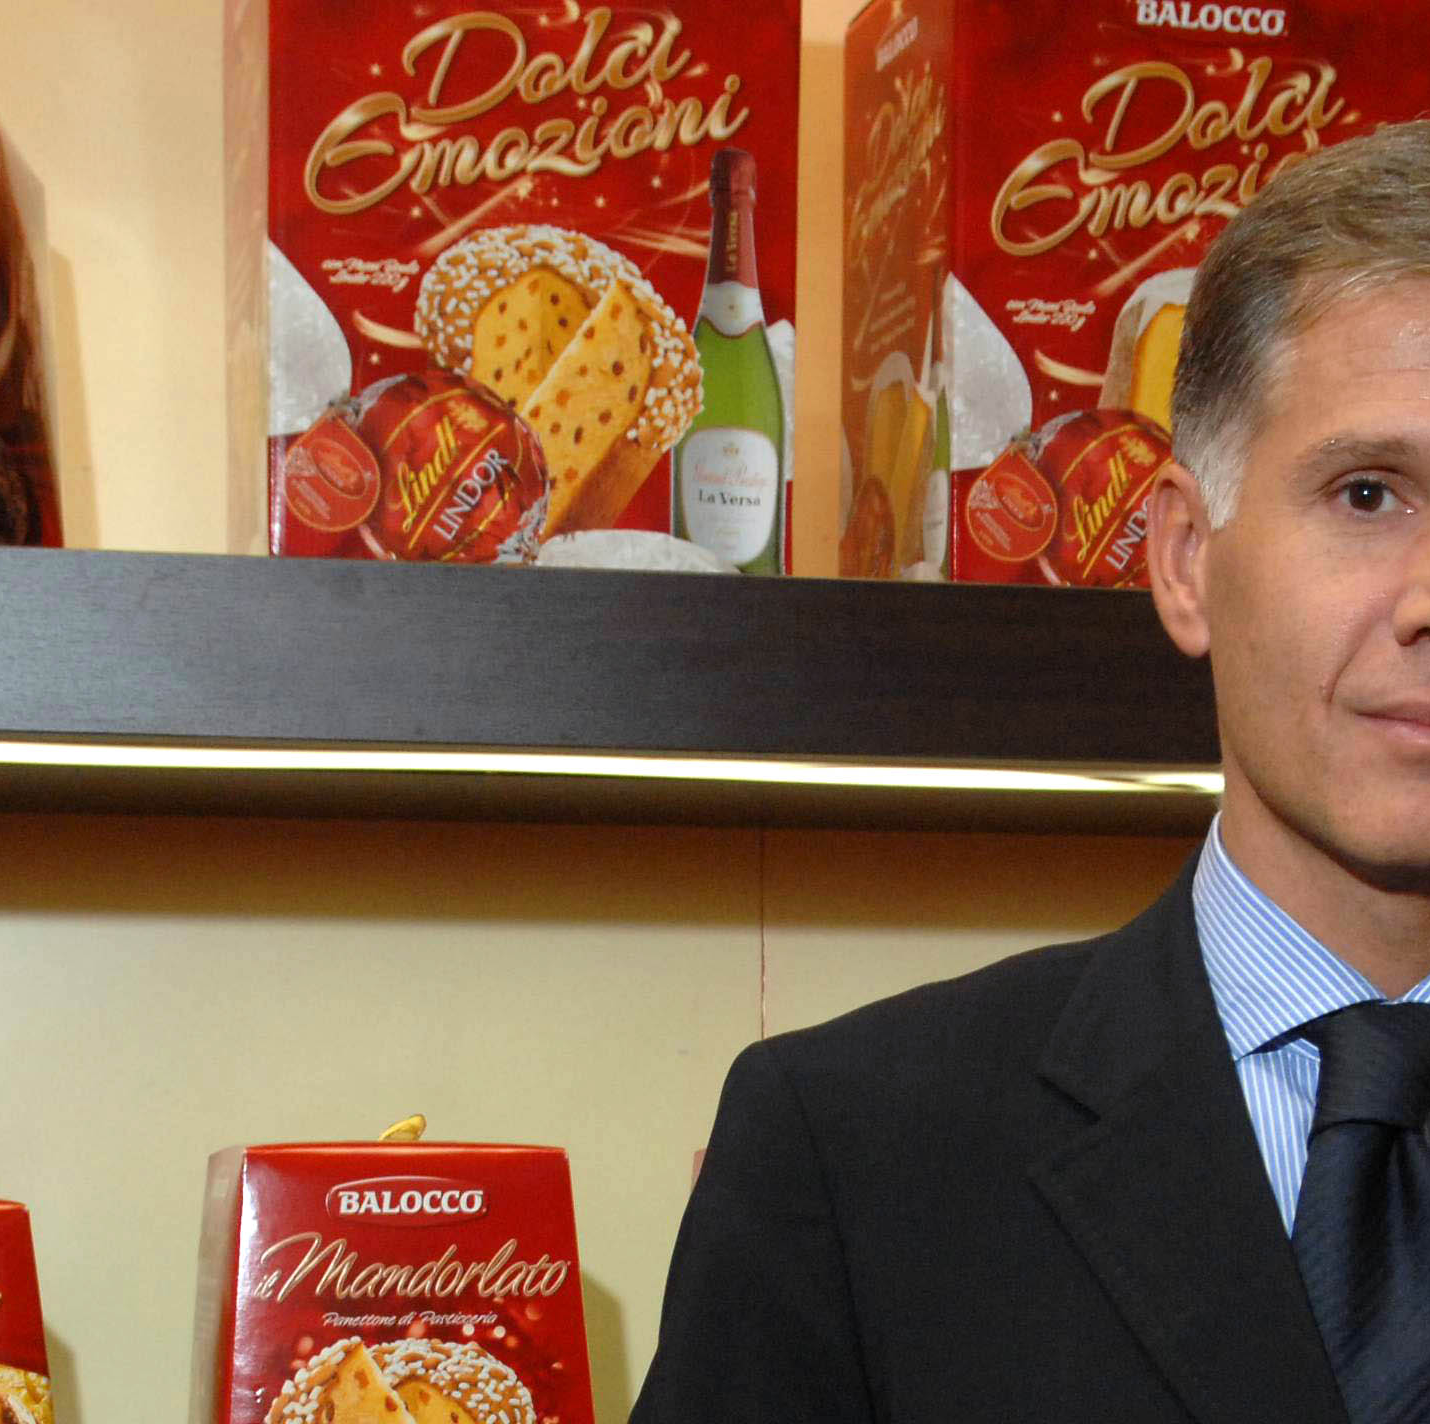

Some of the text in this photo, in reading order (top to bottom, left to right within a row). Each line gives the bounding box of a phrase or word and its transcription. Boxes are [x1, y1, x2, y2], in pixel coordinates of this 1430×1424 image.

[403, 5, 692, 123] Dolci
[1137, 0, 1286, 36] BALOCCO
[303, 74, 750, 215] Emozioni
[1082, 57, 1346, 170] Dolci
[991, 129, 1319, 257] Emozi
[397, 416, 459, 532] Lindt
[433, 448, 509, 541] LINDOR
[720, 490, 762, 507] Versa
[1074, 450, 1129, 563] Lindt
[1105, 494, 1148, 572] LIND
[339, 1189, 484, 1215] BALOCCO
[254, 1231, 569, 1304] il Mandorlato
[323, 1310, 499, 1327] Panettone di Pasticceria
